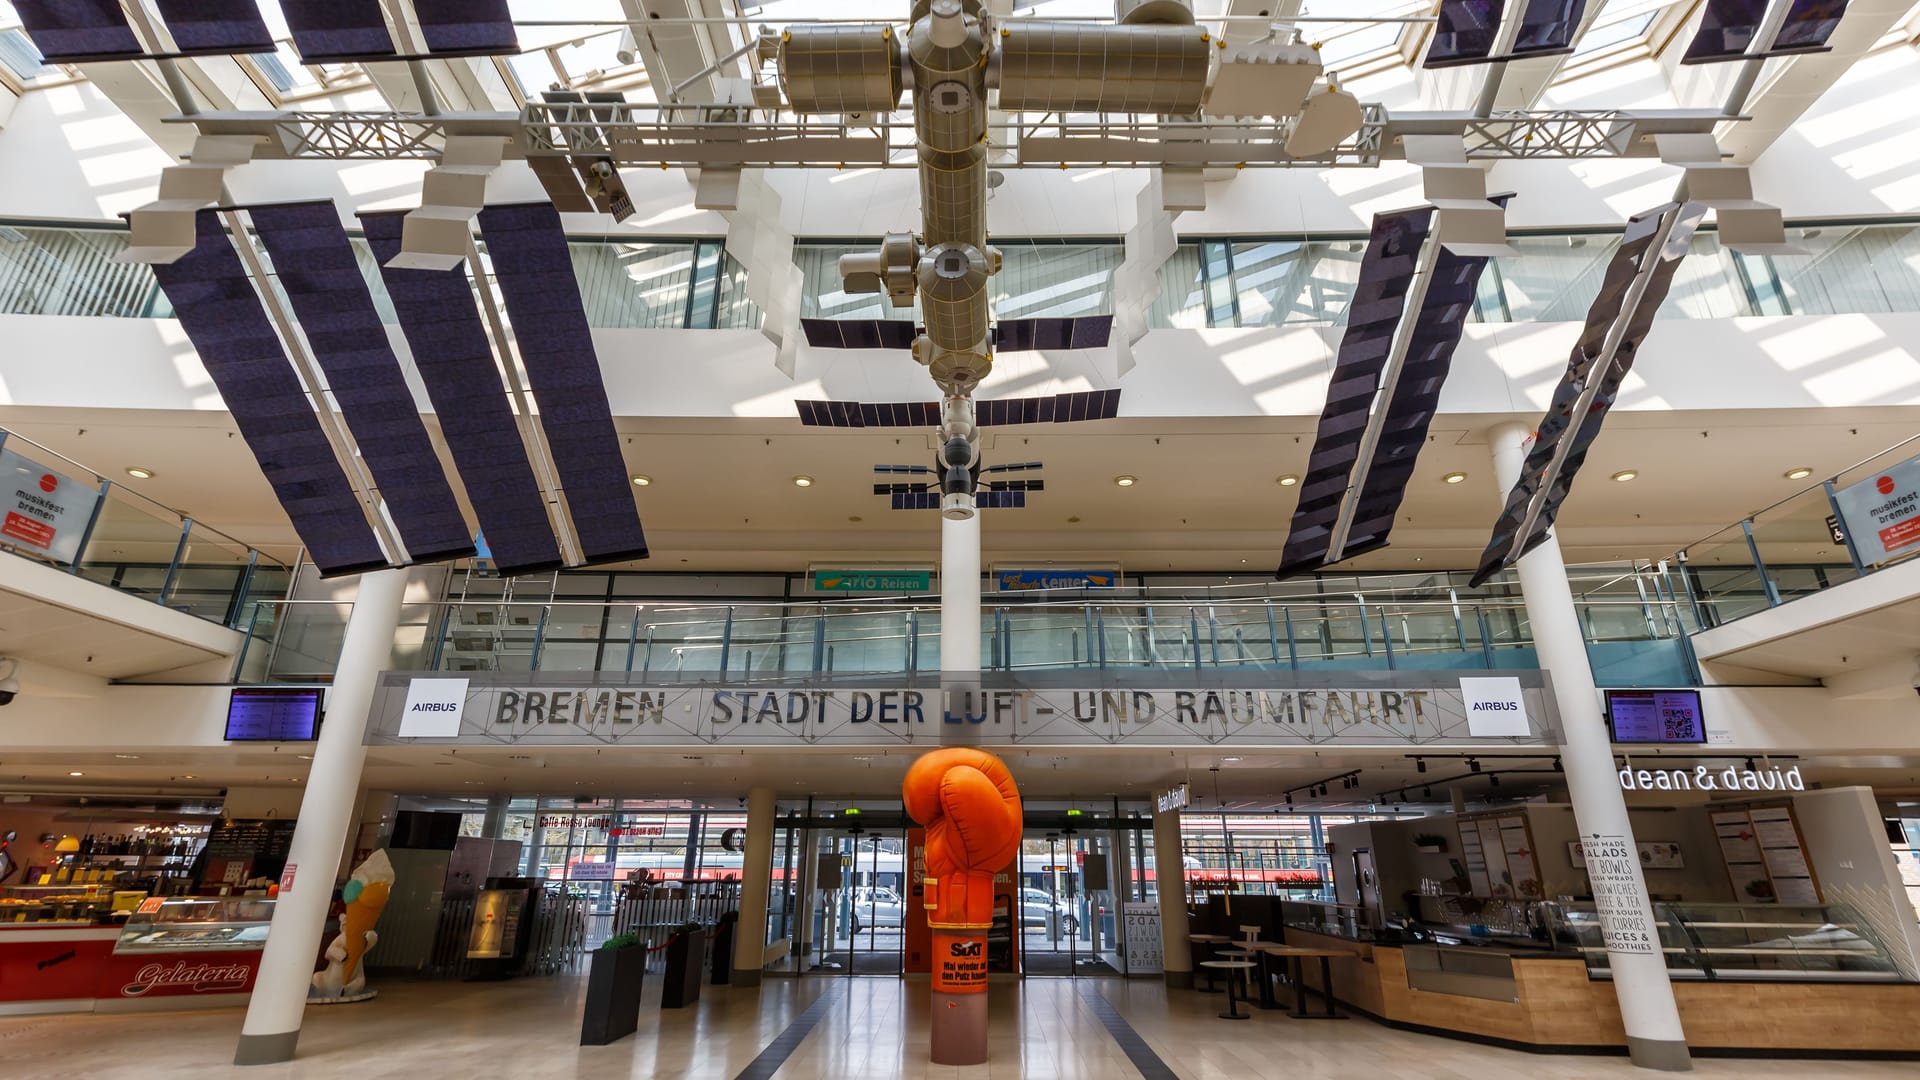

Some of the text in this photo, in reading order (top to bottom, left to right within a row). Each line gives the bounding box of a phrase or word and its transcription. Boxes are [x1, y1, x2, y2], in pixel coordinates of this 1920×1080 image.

[16, 489, 65, 514] musikfest
[1870, 491, 1919, 517] musikfest
[18, 500, 55, 521] bremen
[1879, 504, 1917, 524] bremen
[881, 578, 920, 588] Reisen
[411, 702, 456, 712] AIRBUS
[496, 691, 665, 724] BREMEN
[711, 691, 834, 724] STADT
[851, 691, 924, 724] DER
[1073, 690, 1156, 724] UND
[1176, 690, 1428, 724] RAUMFAHRT
[1472, 702, 1518, 712] AIRBUS
[1586, 848, 1628, 858] ALADS
[1600, 860, 1632, 874] BOWLS
[1594, 882, 1638, 896] NDWICHES
[1626, 896, 1642, 908] TEA
[1613, 918, 1647, 931] CURRIES
[1604, 932, 1649, 942] UICES &
[1607, 943, 1652, 951] MOOTHIES
[944, 962, 956, 970] Mal
[958, 962, 979, 970] wieder
[121, 961, 250, 996] Gelateria
[942, 972, 954, 980] den
[954, 972, 970, 980] Putz
